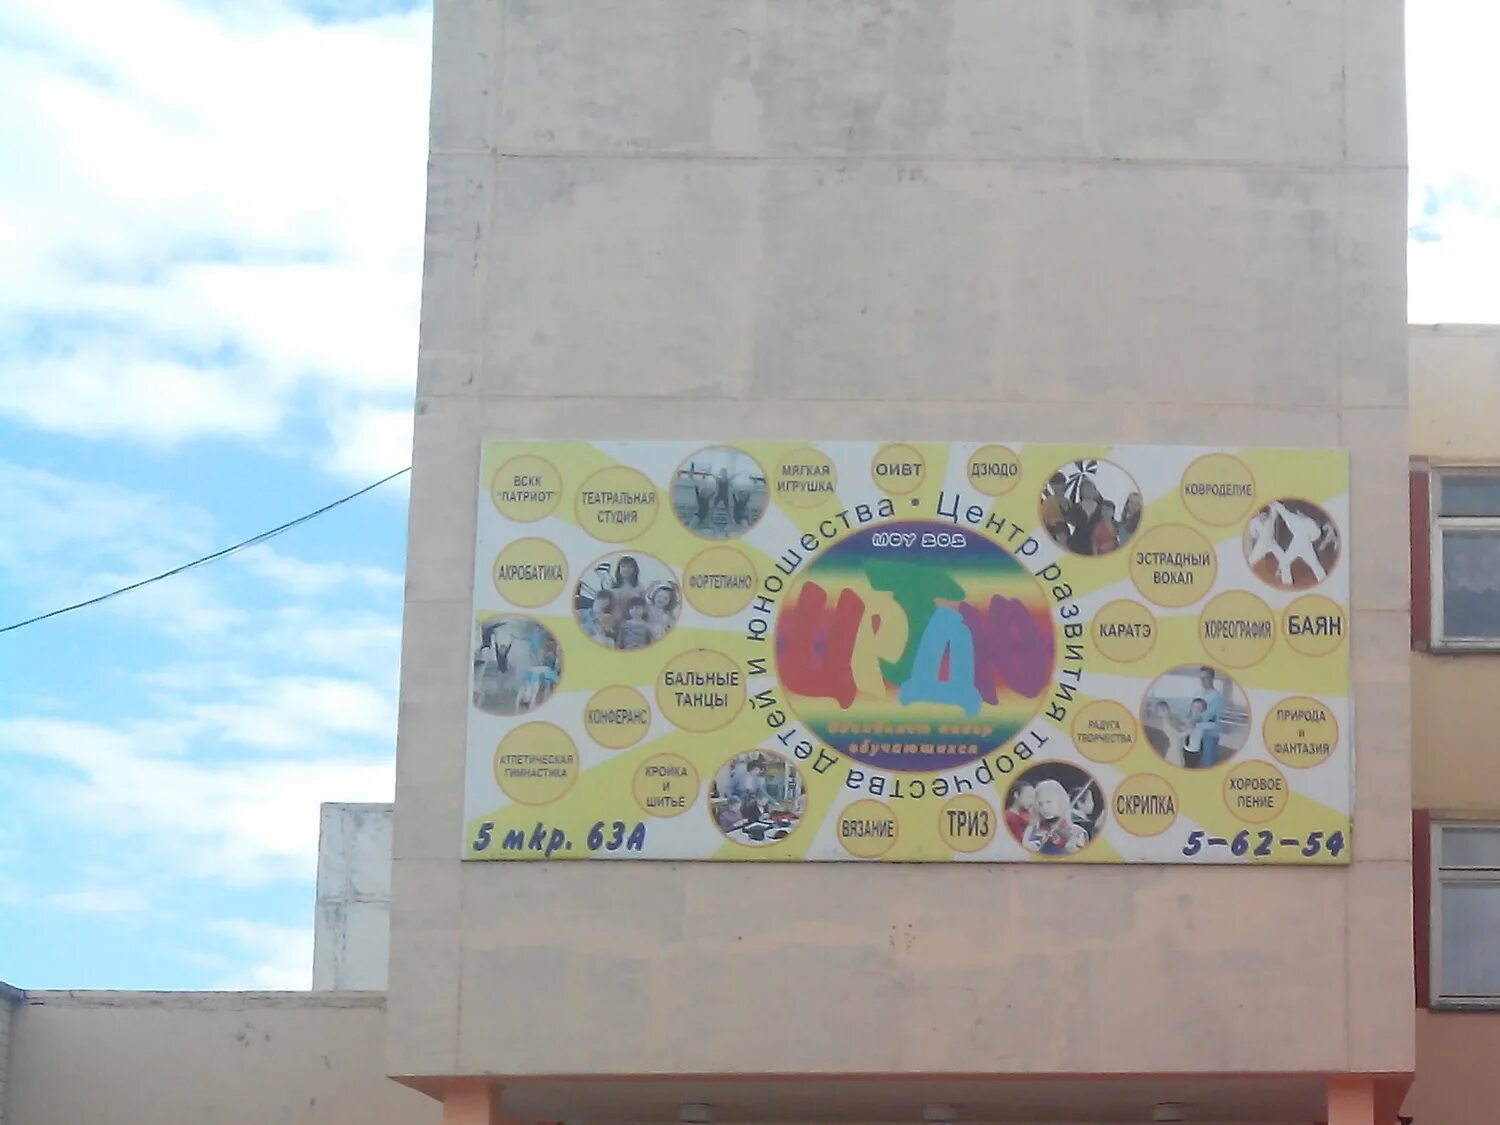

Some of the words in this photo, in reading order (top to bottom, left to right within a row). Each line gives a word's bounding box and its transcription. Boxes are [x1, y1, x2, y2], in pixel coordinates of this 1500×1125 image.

[782, 465, 830, 477] МЯГКАЯ
[876, 463, 922, 476] ОИВТ
[971, 463, 1018, 478] ДЗЮДО
[777, 481, 834, 493] ИГРУШКА
[1184, 483, 1252, 496] КОВРОДЕЛИЕ
[582, 491, 656, 505] ТЕАТРАЛЬНАЯ
[597, 510, 638, 524] СТУДИЯ
[937, 491, 1039, 556] Центр
[872, 533, 916, 548] МОУ
[1137, 551, 1210, 567] ЭСТРАДНЫЙ
[498, 564, 563, 581] АКРОБАТИКА
[747, 498, 896, 641] юношества
[689, 575, 752, 589] ФОРТЕПИАНО
[1153, 572, 1193, 585] ВОКАЛ
[1100, 624, 1151, 638] КАРАТЭ
[1204, 620, 1272, 639] ХОРЕОГРАФИЯ
[1289, 615, 1342, 636] БАЯН
[1034, 562, 1084, 722] развития
[665, 672, 739, 686] БАЛЬНЫЕ
[675, 692, 728, 709] ТАНЦЫ
[588, 709, 648, 725] КОНФЕРАНС
[1277, 709, 1326, 723] ПРИРОДА
[749, 689, 839, 774] детей
[1274, 743, 1330, 754] ФАНТАЗИЯ
[499, 754, 574, 765] АТЛЕТИЧЕСКАЯ
[846, 730, 1049, 799] творчества
[504, 768, 568, 778] ГИМНАСТИКА
[1229, 778, 1282, 790] ХОРОВОЕ
[1116, 795, 1175, 815] СКРИПКА
[1237, 796, 1274, 808] ПЕНИЕ
[842, 820, 894, 837] ВЯЗАНИЕ
[946, 811, 989, 837] ТРИЗ
[472, 821, 495, 851] 5
[502, 821, 573, 859] мкр.
[586, 821, 648, 852] 63А
[1182, 829, 1345, 858] 5-62-54
